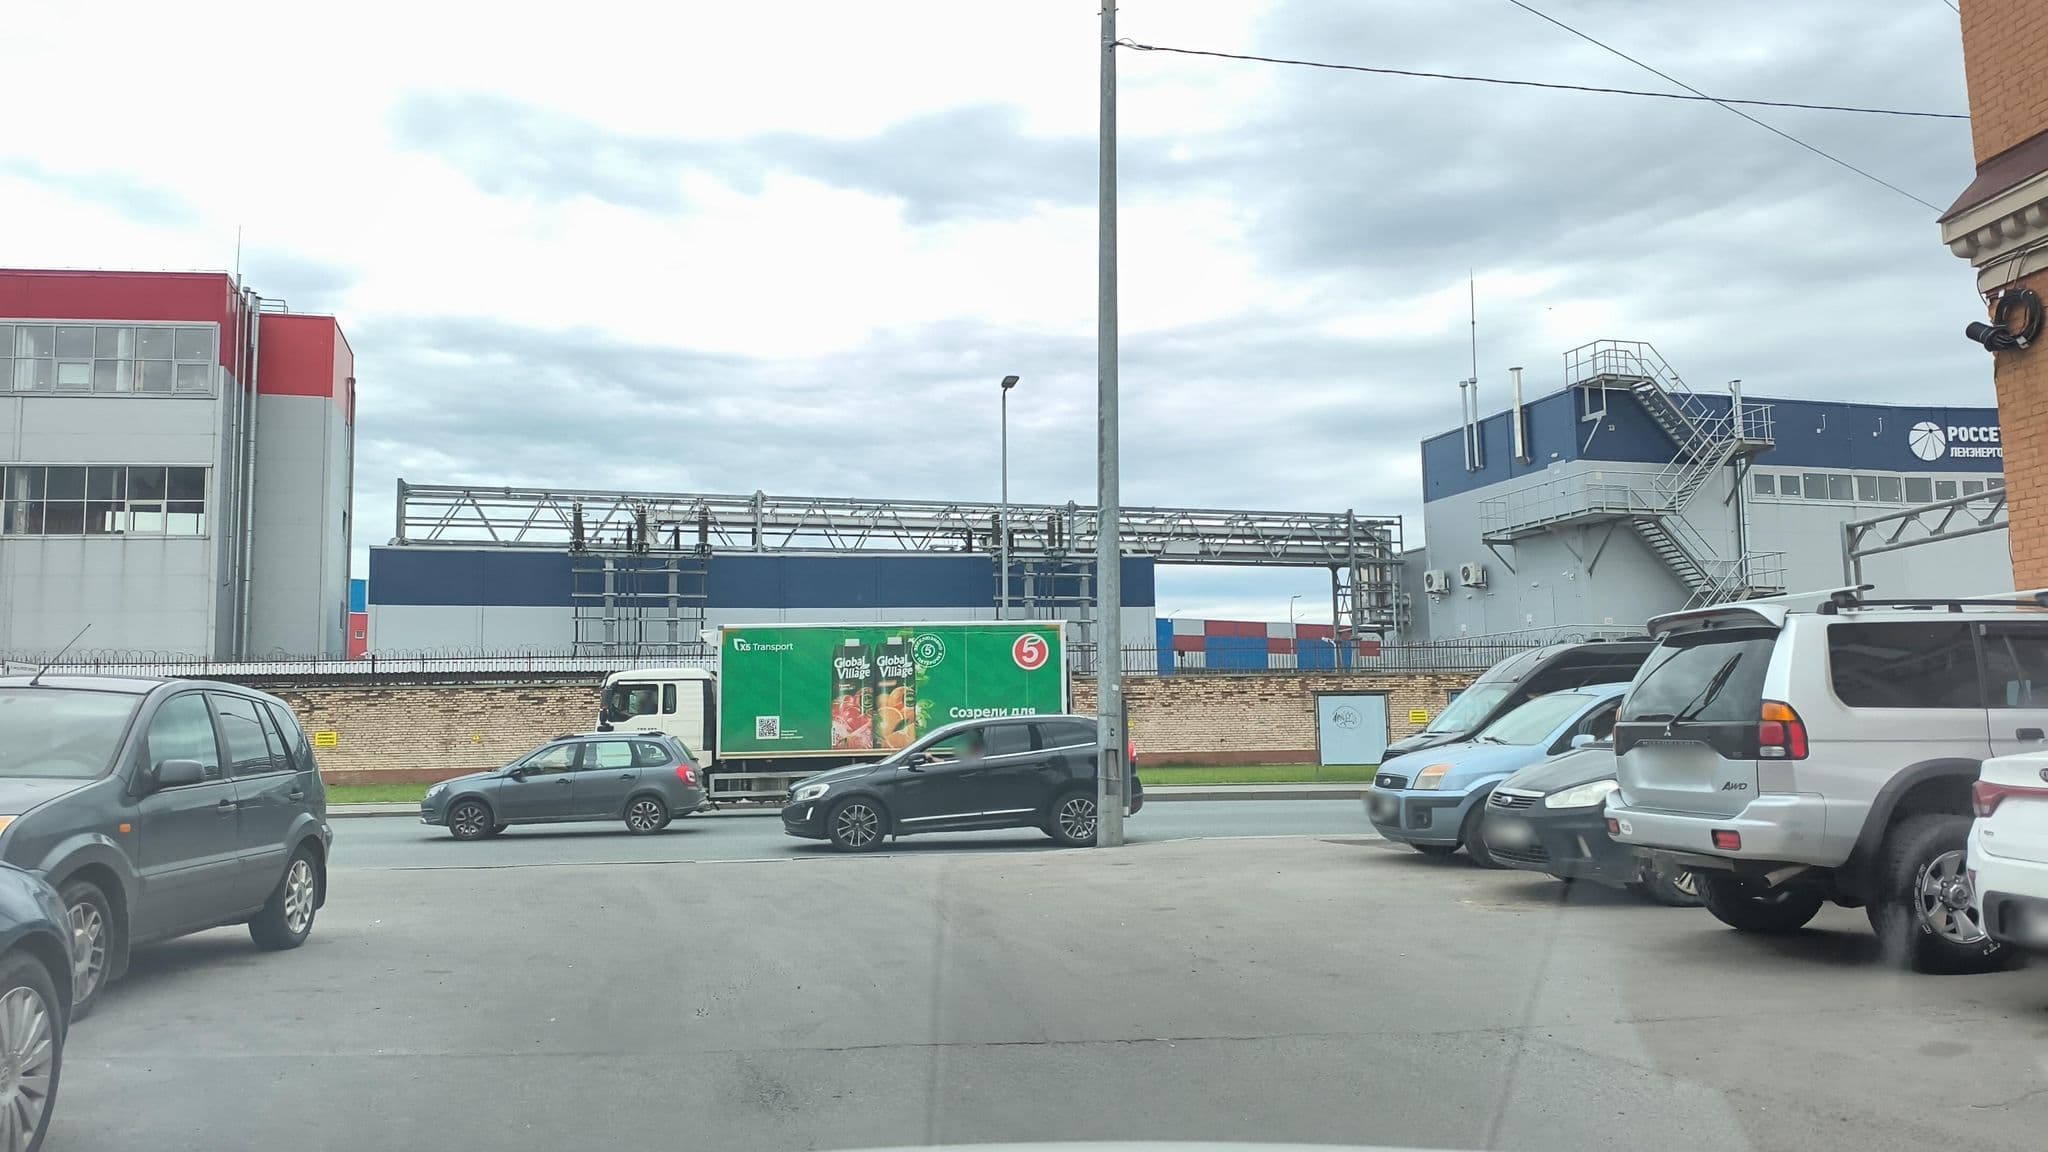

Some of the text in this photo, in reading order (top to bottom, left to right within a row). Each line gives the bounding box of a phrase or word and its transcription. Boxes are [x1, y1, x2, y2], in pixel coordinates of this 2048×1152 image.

[1950, 447, 2004, 458] ЛЕНЭНЕРГО
[752, 642, 794, 653] Transport
[1022, 636, 1041, 663] 5
[834, 656, 870, 669] Global
[876, 654, 912, 667] Global
[837, 666, 871, 680] Village
[879, 664, 914, 678] Village
[949, 706, 1036, 719] Созрели для
[1721, 781, 1748, 791] AWD
